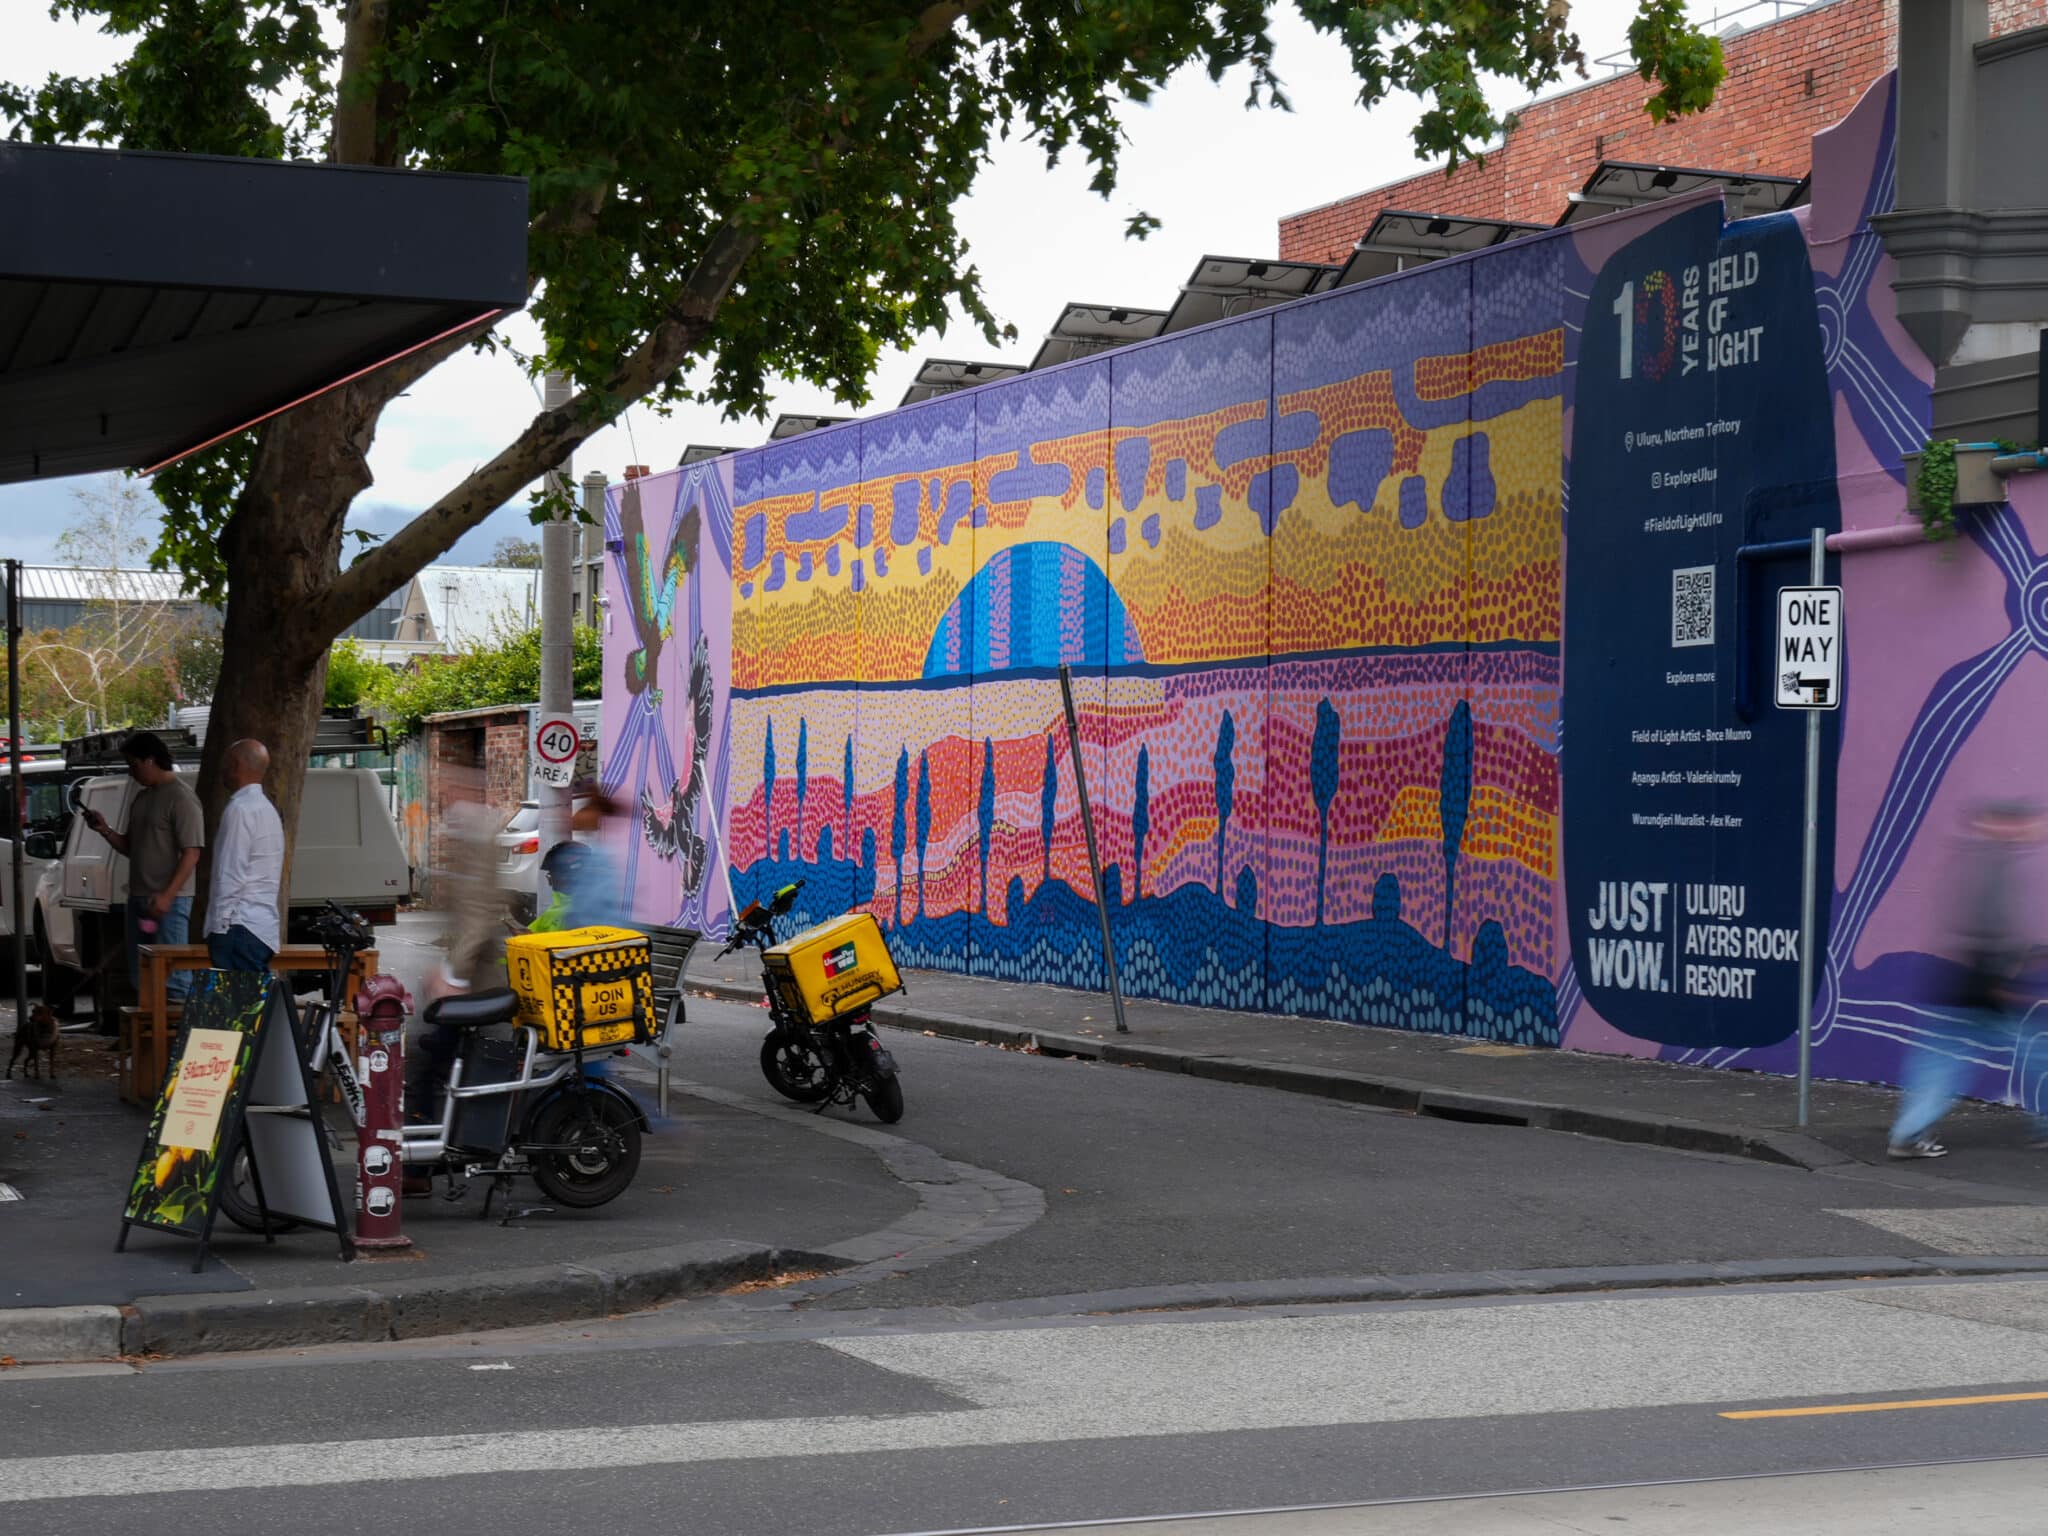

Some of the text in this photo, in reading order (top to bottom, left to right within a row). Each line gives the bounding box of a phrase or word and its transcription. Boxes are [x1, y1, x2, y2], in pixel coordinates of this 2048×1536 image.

[1682, 265, 1699, 376] YEARS
[1664, 425, 1704, 443] Northern
[1788, 599, 1831, 626] ONE
[1784, 637, 1833, 662] WAY
[1666, 671, 1716, 686] Explore more
[543, 732, 572, 753] 40
[1632, 730, 1650, 743] Field
[1650, 730, 1659, 742] of
[1659, 730, 1679, 745] Light
[1680, 729, 1701, 742] Artist
[1724, 728, 1752, 741] Munro
[533, 765, 570, 783] AREA
[1661, 771, 1681, 783] Artist
[1632, 813, 1673, 829] Wurundjeri
[1674, 814, 1705, 826] Muralist
[1724, 815, 1743, 827] Kerr
[1588, 881, 1668, 932] JUST
[1685, 924, 1799, 961] AYERS ROCK
[1588, 937, 1669, 993] WOW.
[1685, 964, 1756, 1000] RESORT
[591, 988, 624, 1004] JOIN
[599, 1004, 617, 1016] US
